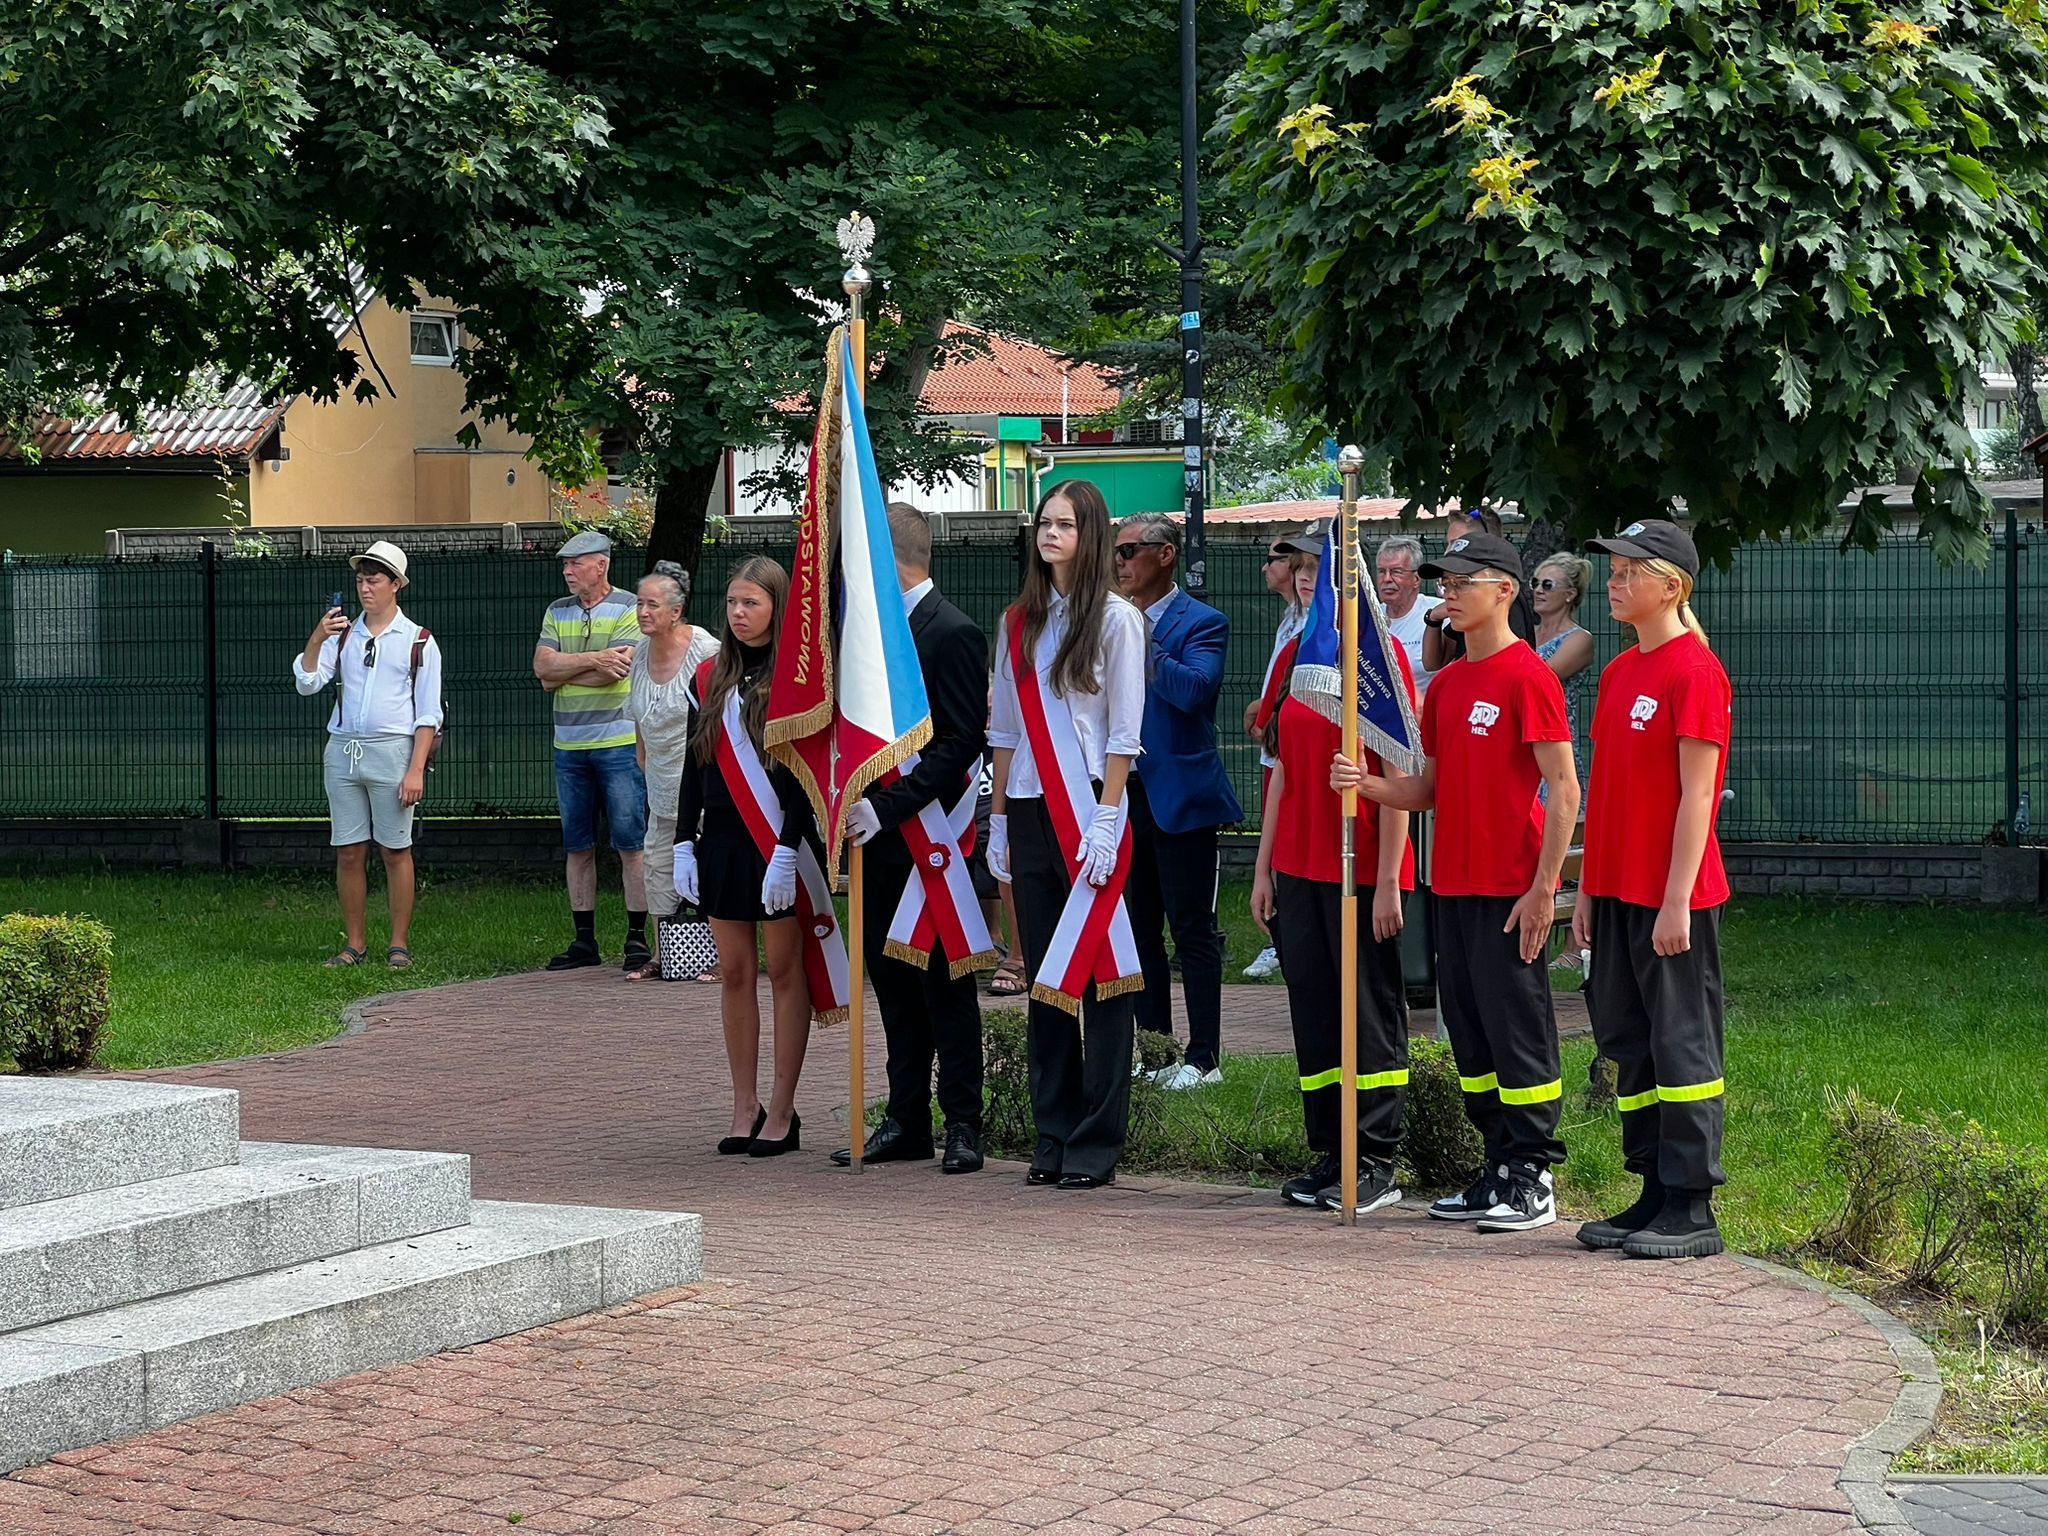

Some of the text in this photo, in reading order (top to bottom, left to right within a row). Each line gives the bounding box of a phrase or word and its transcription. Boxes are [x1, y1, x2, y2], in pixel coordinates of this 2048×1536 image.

[1357, 648, 1391, 699] łodzieżowa
[1471, 726, 1489, 736] HEL
[1631, 721, 1646, 731] HEL
